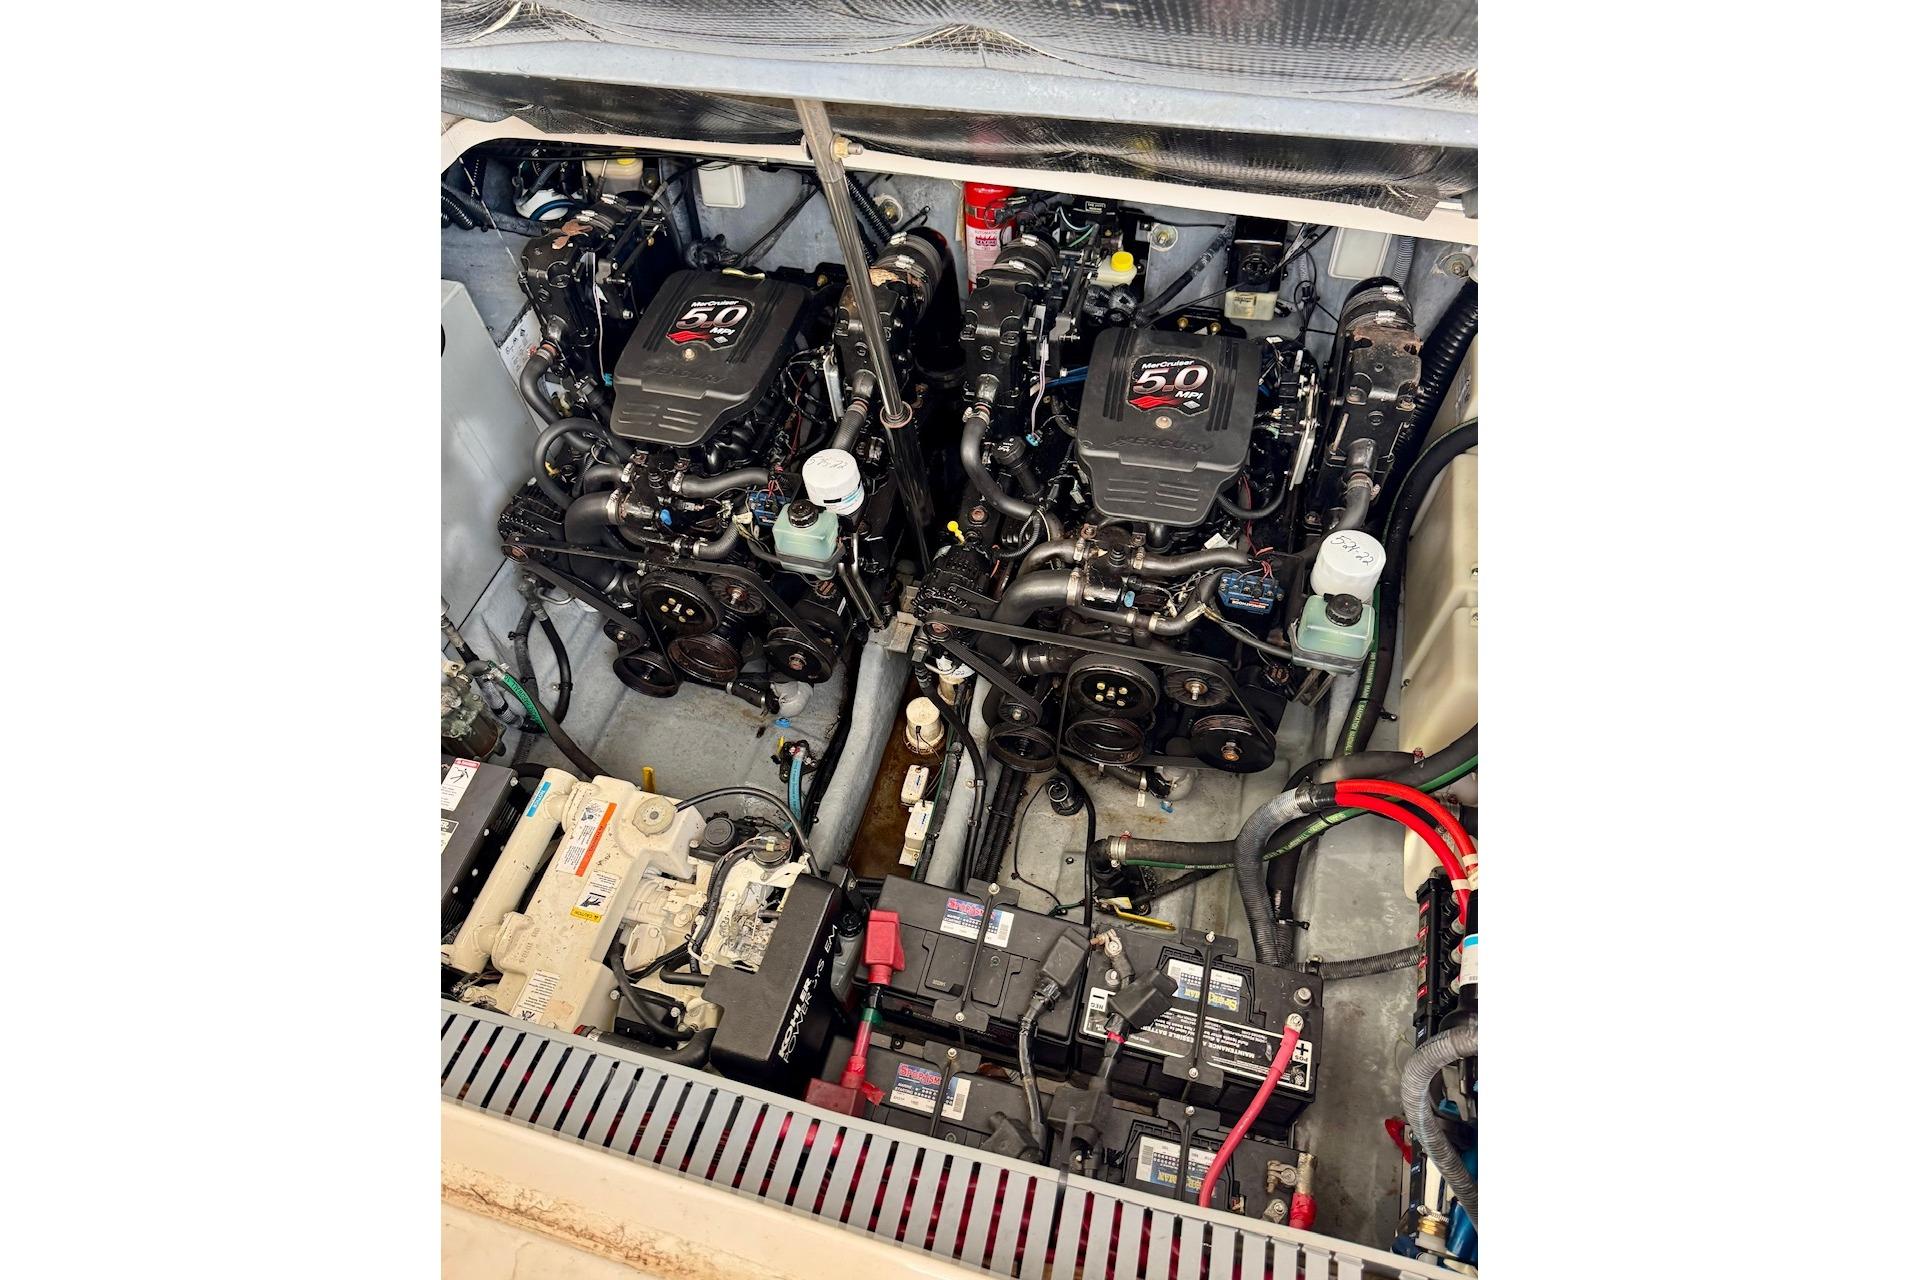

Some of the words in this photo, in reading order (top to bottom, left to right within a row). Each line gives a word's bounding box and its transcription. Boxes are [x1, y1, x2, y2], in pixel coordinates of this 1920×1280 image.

[676, 305, 748, 329] 5.0
[709, 327, 735, 335] MPI
[1142, 360, 1194, 370] MerCruiser
[1133, 365, 1208, 394] 5.0
[1175, 390, 1204, 400] MPI
[778, 978, 812, 1059] KOHLER
